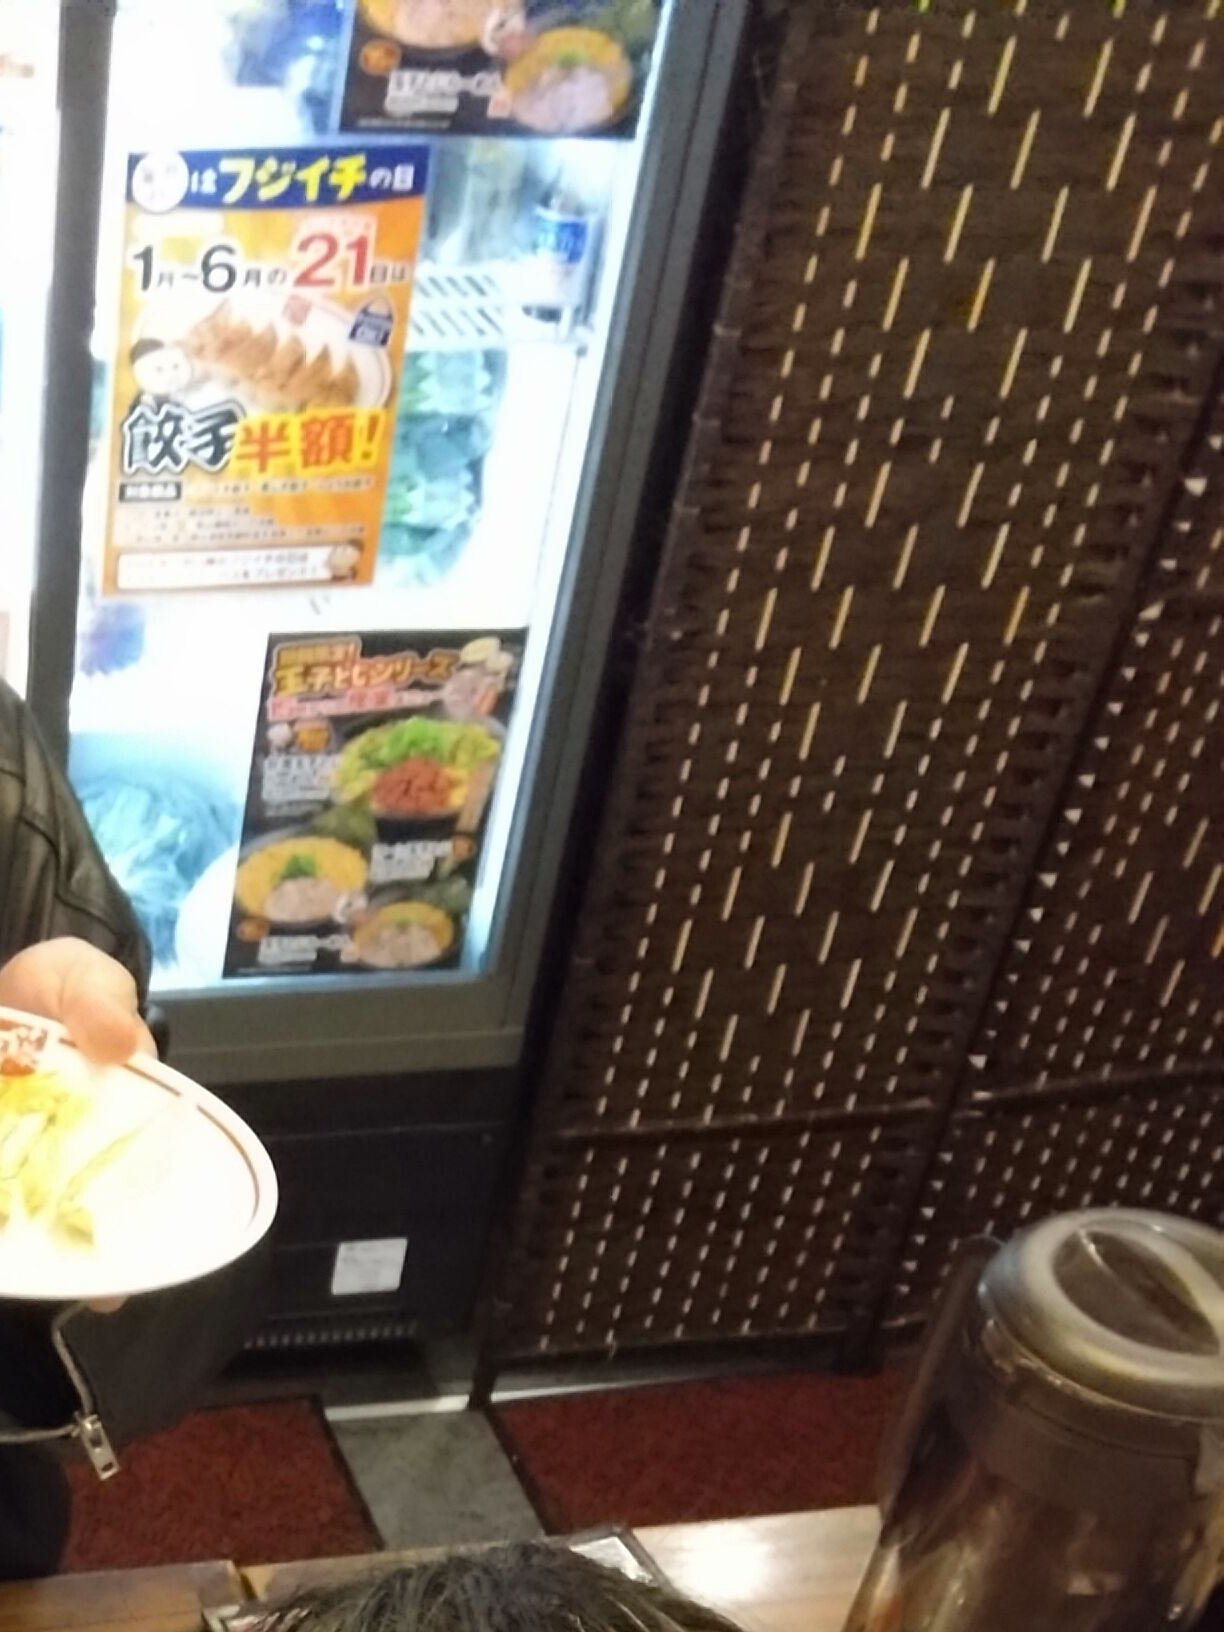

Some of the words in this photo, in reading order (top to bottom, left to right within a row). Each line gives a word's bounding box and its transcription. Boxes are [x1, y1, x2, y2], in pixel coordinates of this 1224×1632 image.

[190, 153, 416, 204] はフジイチの日
